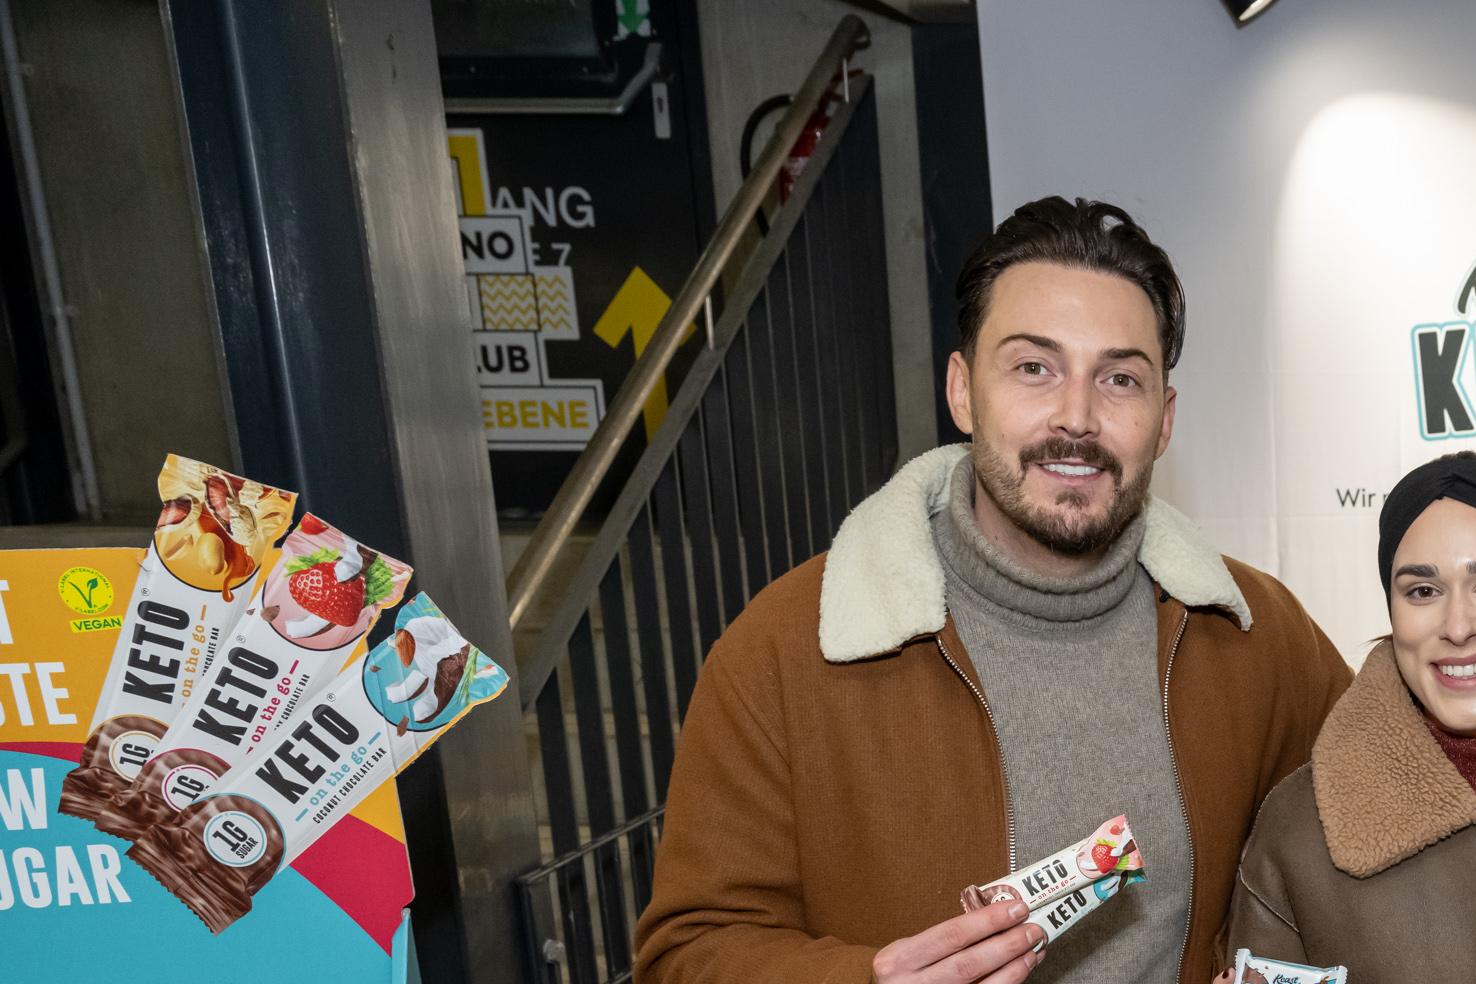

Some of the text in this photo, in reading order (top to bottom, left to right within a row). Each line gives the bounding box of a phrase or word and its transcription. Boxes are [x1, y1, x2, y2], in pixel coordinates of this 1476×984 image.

[1336, 488, 1375, 508] Wir
[73, 618, 122, 631] VEGAN
[122, 600, 190, 704] KETO
[181, 624, 205, 698] on the go
[0, 662, 78, 726] TE
[192, 647, 279, 746] KETO
[251, 677, 291, 743] on the go
[255, 703, 360, 805] KETO
[309, 746, 367, 806] on the go
[312, 747, 387, 824] COCONUT CHOCOLATE BAR
[235, 837, 259, 859] SUGAR
[1022, 859, 1068, 897] KETO
[1046, 890, 1087, 930] KETO
